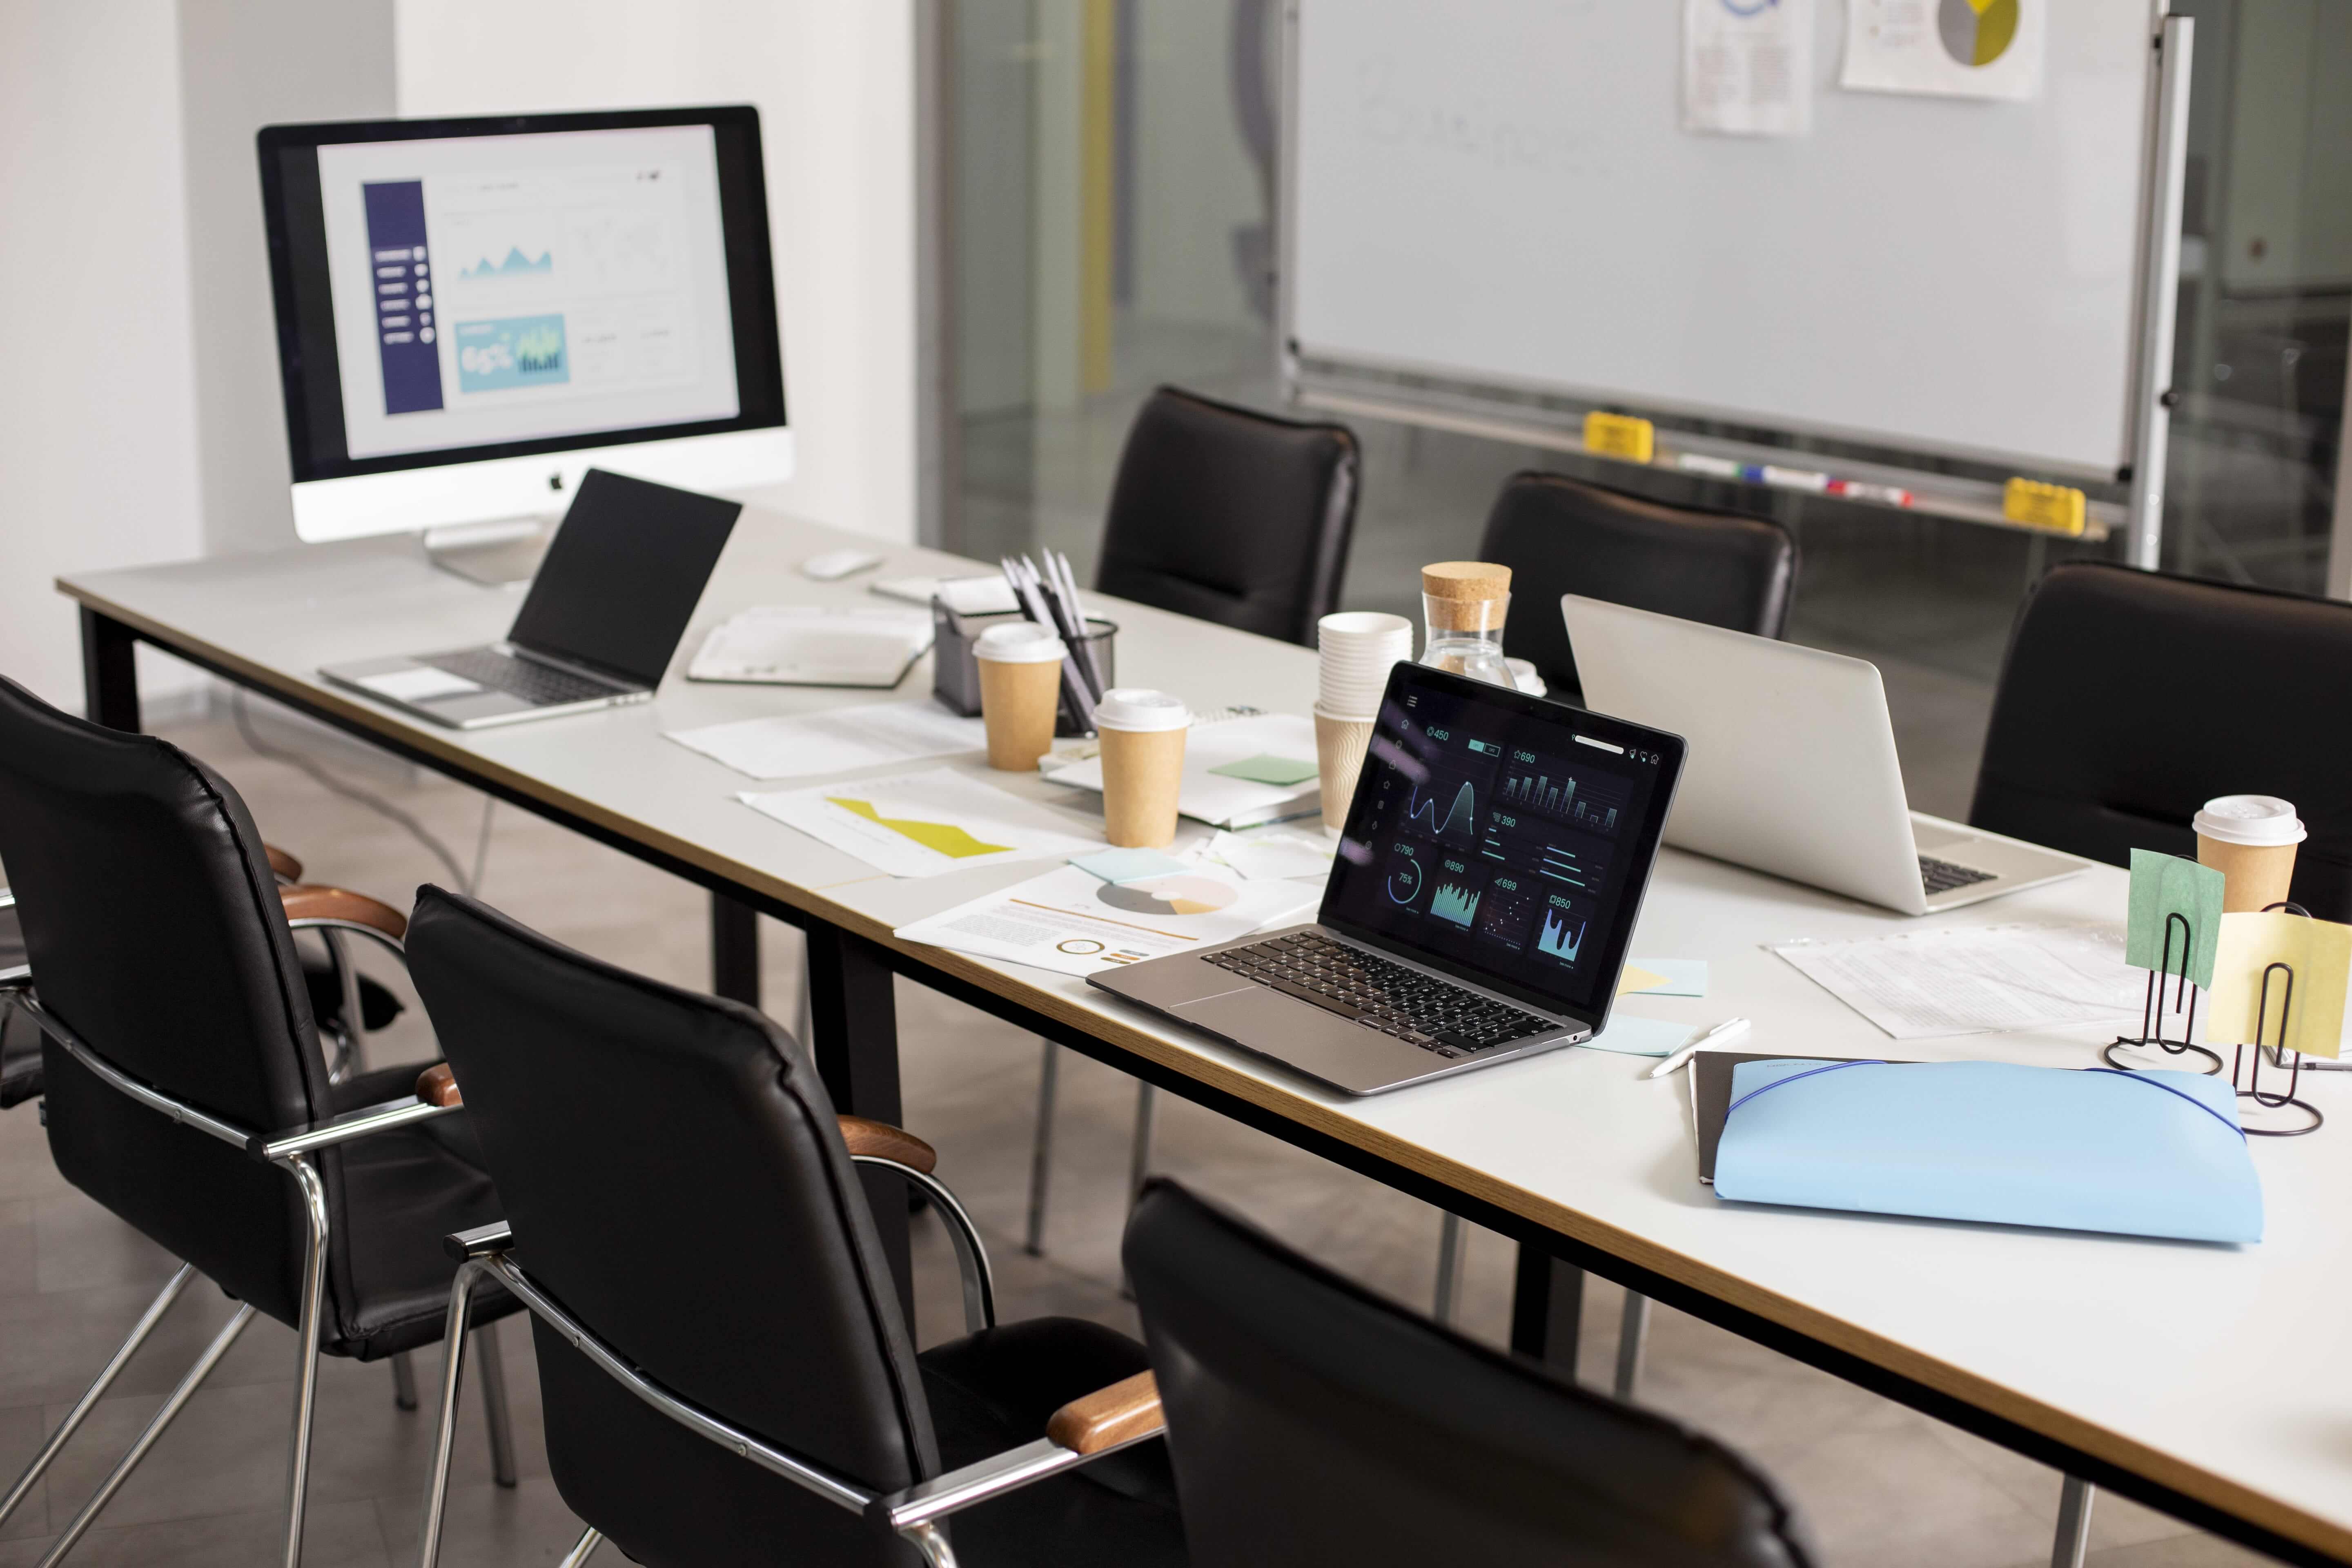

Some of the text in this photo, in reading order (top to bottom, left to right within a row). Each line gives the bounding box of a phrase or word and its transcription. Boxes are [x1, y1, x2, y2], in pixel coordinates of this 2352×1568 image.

[1434, 730, 1449, 741] 450
[1521, 752, 1535, 764] 690
[1501, 816, 1516, 827] 390
[1401, 844, 1414, 856] 790
[1450, 862, 1464, 873] 890
[1399, 872, 1412, 884] 75%
[1503, 879, 1517, 891] 699
[1556, 898, 1570, 909] 850
